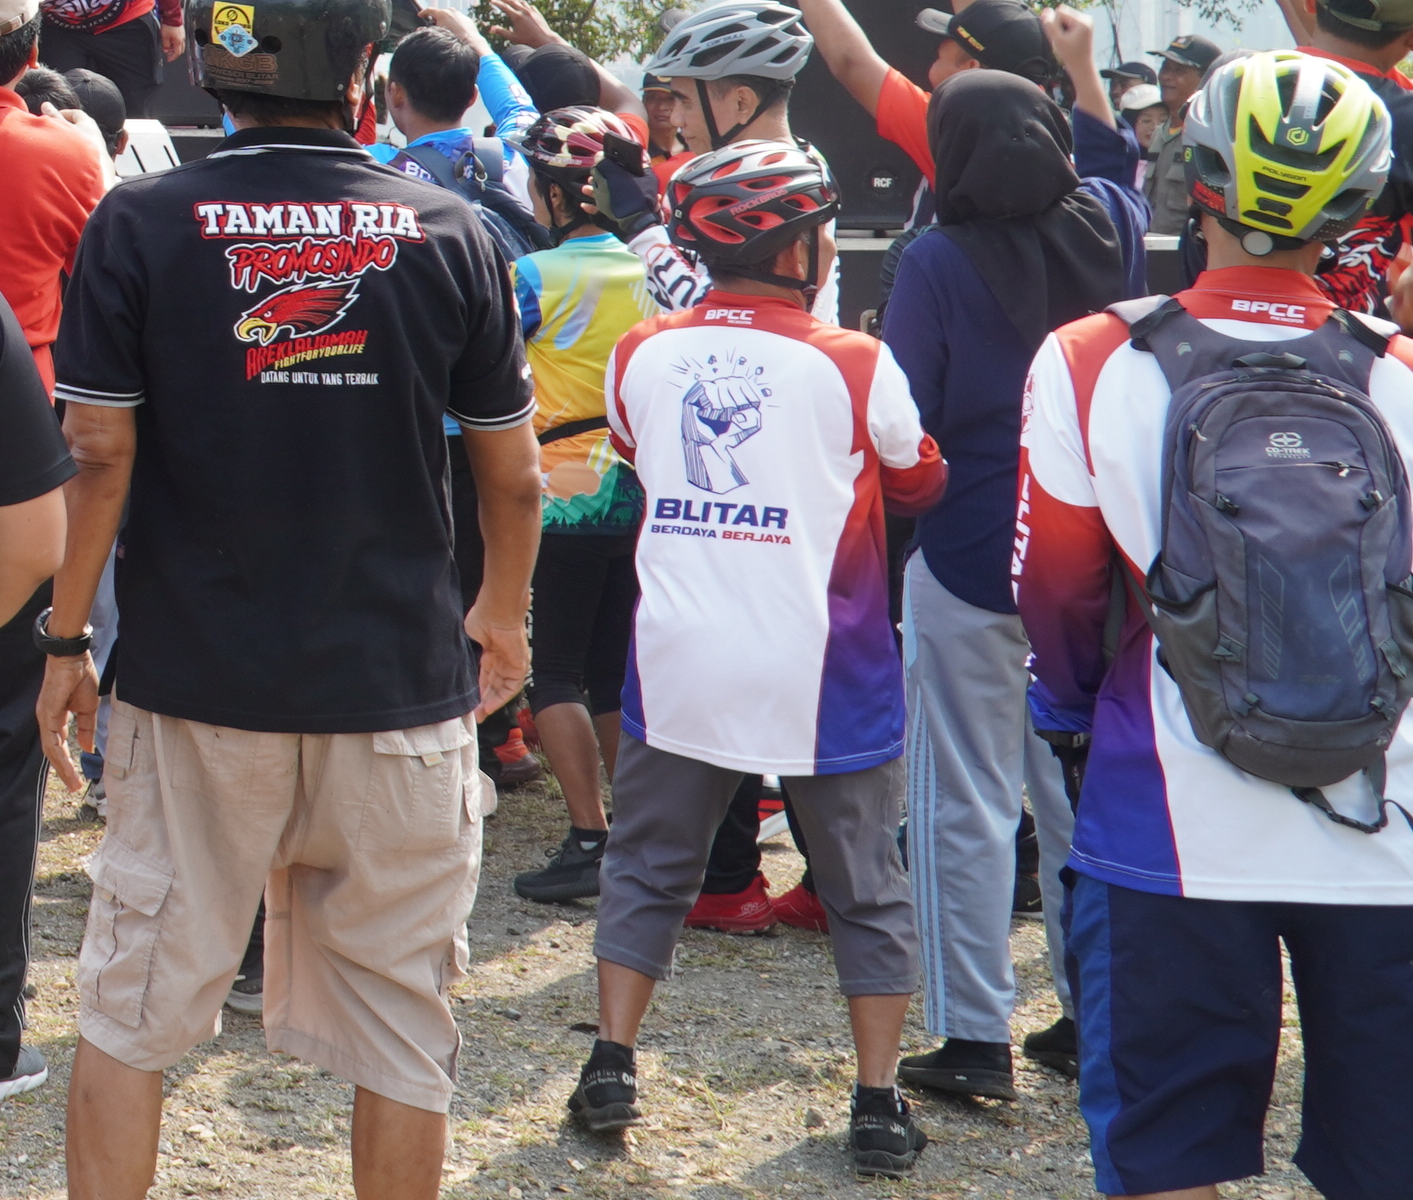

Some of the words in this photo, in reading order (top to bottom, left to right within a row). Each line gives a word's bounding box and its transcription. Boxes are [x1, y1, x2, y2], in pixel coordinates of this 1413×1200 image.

[873, 177, 893, 188] RCF
[1262, 165, 1307, 181] POLYGON
[197, 203, 342, 236] TAMAN
[351, 203, 423, 239] RIA
[227, 233, 396, 291] PROMOSINDO
[704, 308, 755, 321] BPCC
[1231, 299, 1306, 319] BPCC
[261, 371, 289, 383] DATANG
[292, 371, 319, 384] UNTUK
[321, 373, 343, 385] YANG
[345, 373, 379, 385] TERBAIK
[654, 498, 789, 530] BLITAR
[650, 524, 717, 539] BERDAYA
[722, 530, 792, 545] BERJAYA
